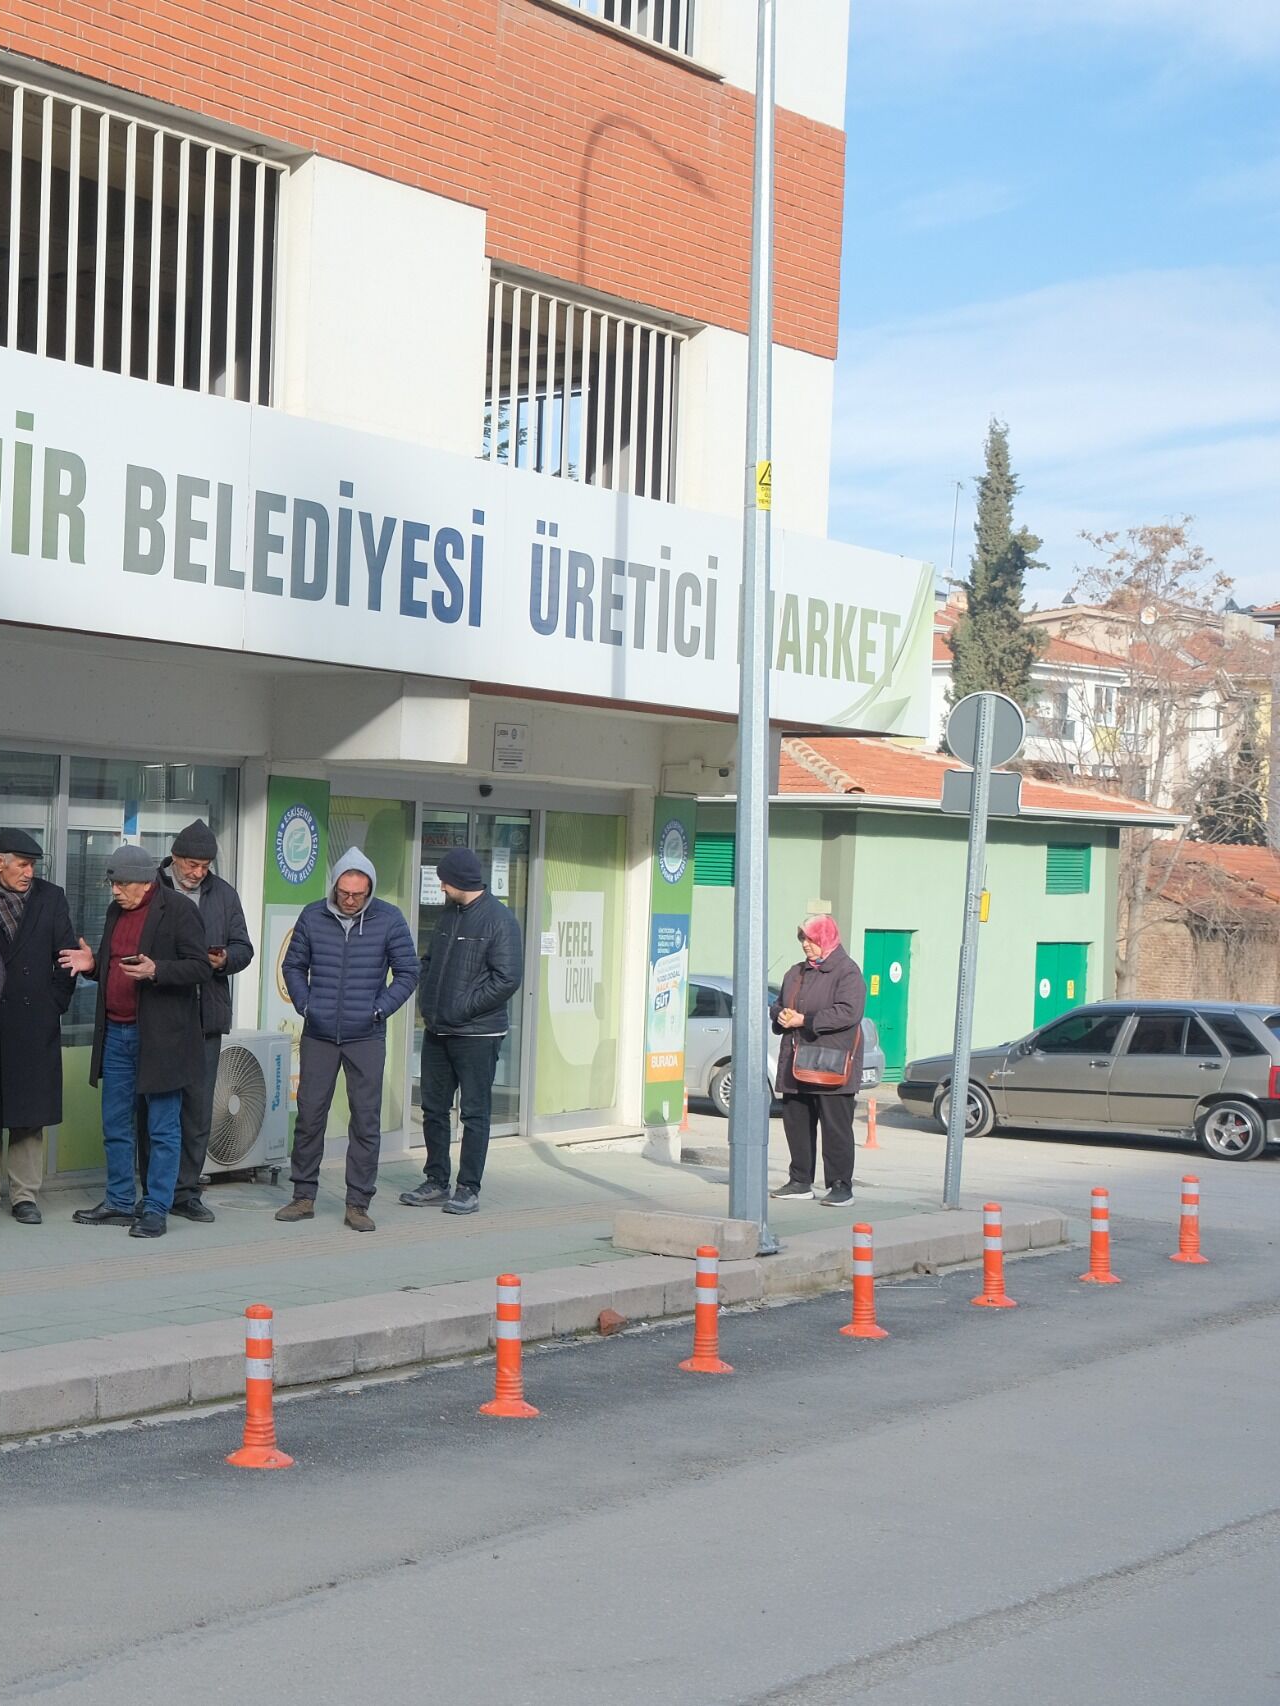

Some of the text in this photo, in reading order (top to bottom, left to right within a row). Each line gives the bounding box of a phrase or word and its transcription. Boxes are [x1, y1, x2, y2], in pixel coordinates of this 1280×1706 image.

[123, 463, 485, 628] BELEDİYESİ
[529, 519, 718, 660] ÜRETİCİ
[737, 584, 901, 687] ARKET
[558, 921, 594, 957] YEREL
[565, 958, 593, 1004] ÜRÜN
[655, 992, 670, 1009] SÜT
[651, 1055, 678, 1068] BURADA
